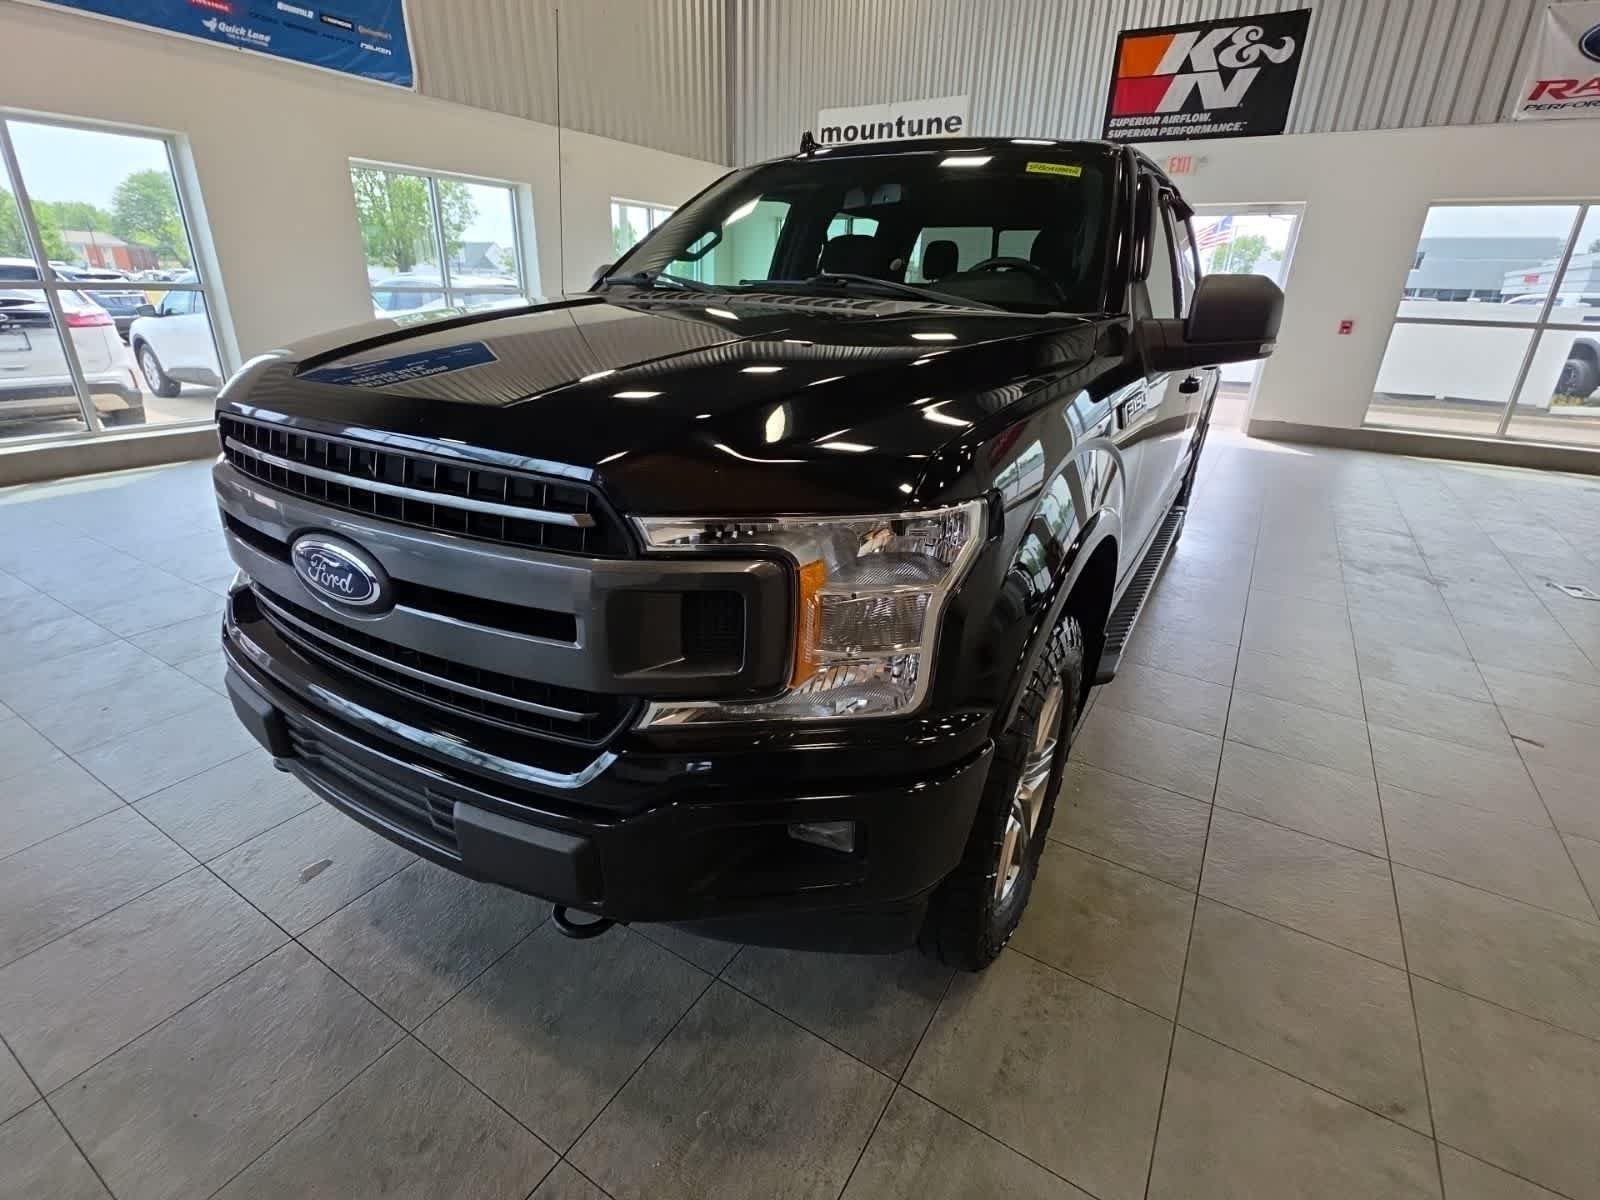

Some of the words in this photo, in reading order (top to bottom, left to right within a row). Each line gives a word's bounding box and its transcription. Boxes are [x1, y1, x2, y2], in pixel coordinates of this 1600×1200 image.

[218, 21, 247, 36] Quick
[247, 28, 272, 42] Lane
[820, 115, 963, 144] mountune
[1109, 115, 1160, 128] SUPERIOR
[1161, 112, 1212, 124] AIRFLOW.
[1107, 126, 1159, 139] SUPERIOR
[1168, 155, 1192, 174] EXIT
[307, 553, 354, 594] Ford
